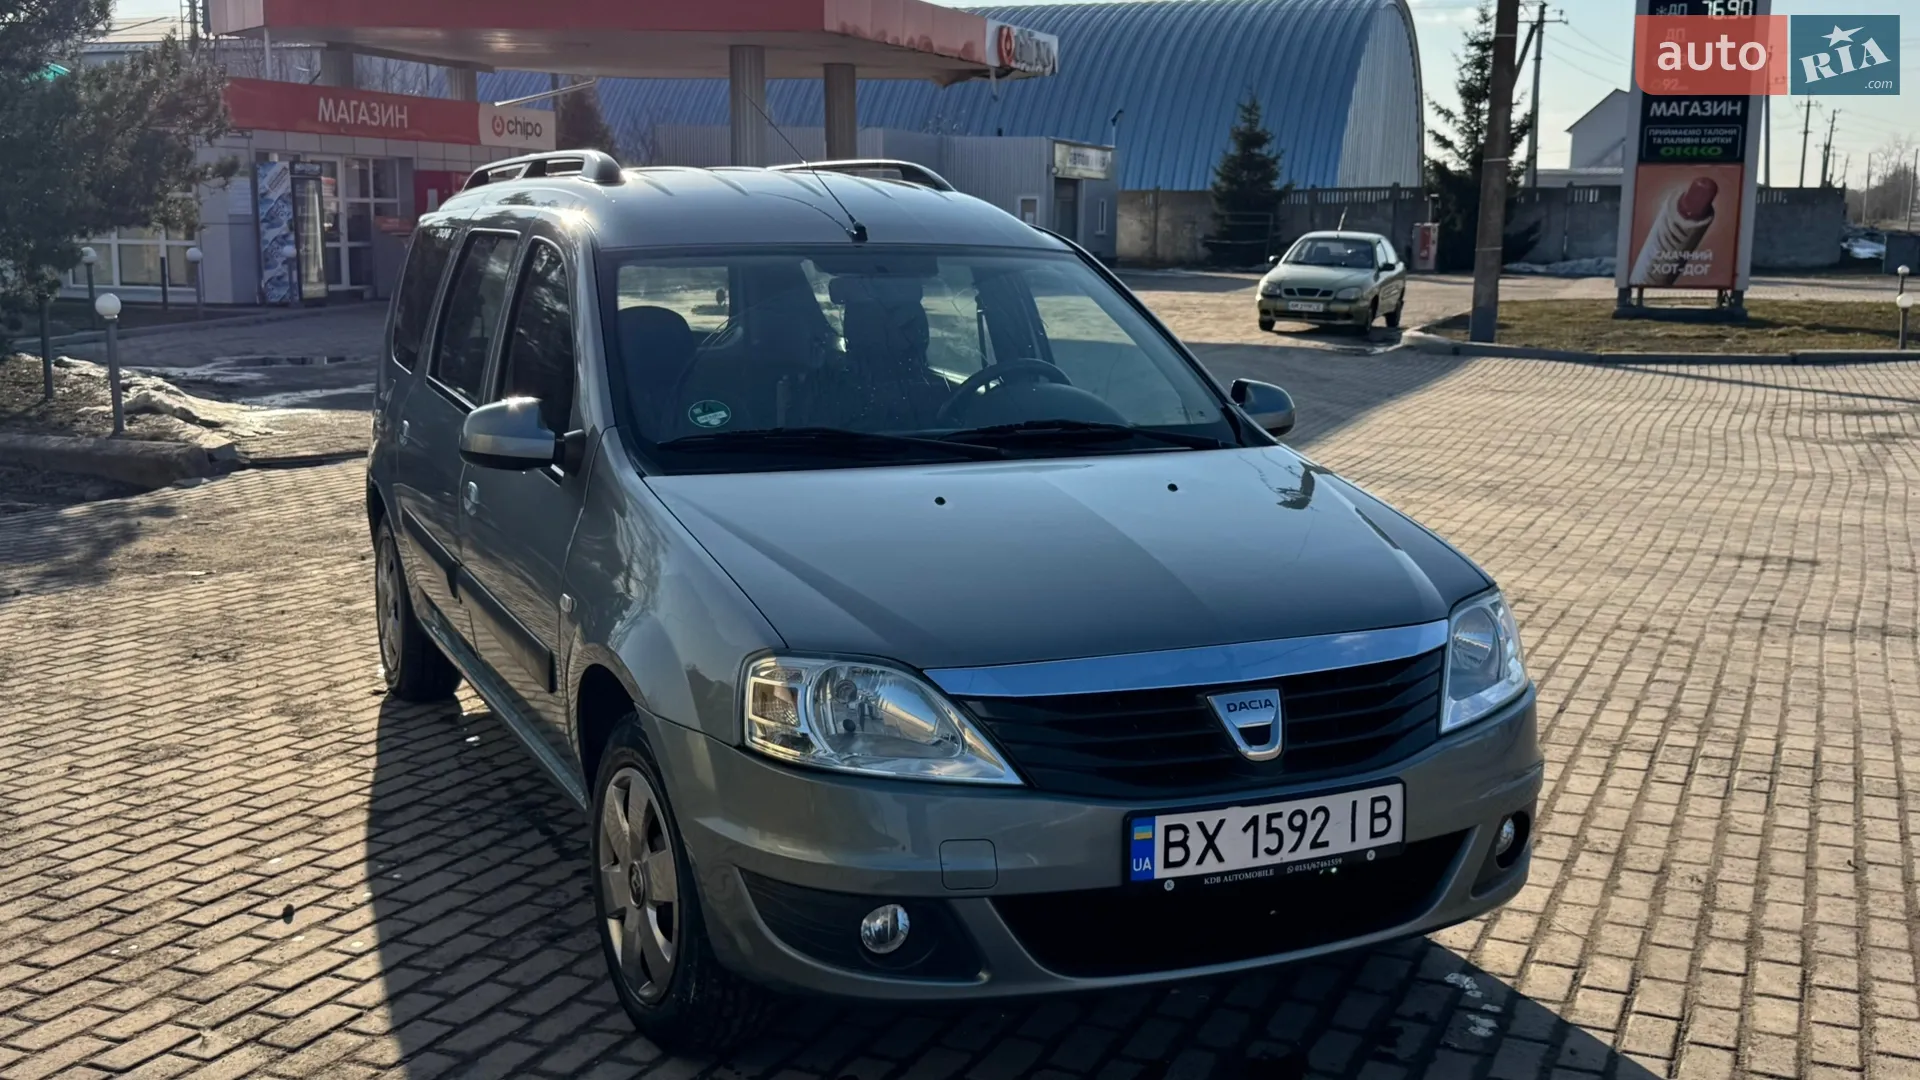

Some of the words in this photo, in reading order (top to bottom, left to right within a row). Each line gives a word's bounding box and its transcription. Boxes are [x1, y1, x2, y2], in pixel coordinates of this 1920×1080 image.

[318, 97, 408, 129] МАГАЗИН
[1650, 101, 1741, 117] МАГАЗИН
[506, 117, 542, 140] chipo
[1649, 128, 1701, 136] ПРИЙМАЄМО
[1703, 128, 1737, 136] ТАЛОНИ
[1655, 249, 1712, 260] СМАЧНИЙ
[1652, 264, 1711, 276] ХОТ-ДОГ
[1226, 698, 1274, 713] DACIA
[1163, 818, 1227, 869] BX
[1241, 805, 1330, 859] 1592
[1350, 795, 1392, 843] IB
[1133, 857, 1151, 872] UA
[1204, 876, 1222, 885] KDB
[1223, 868, 1274, 883] AUTOMOBILE
